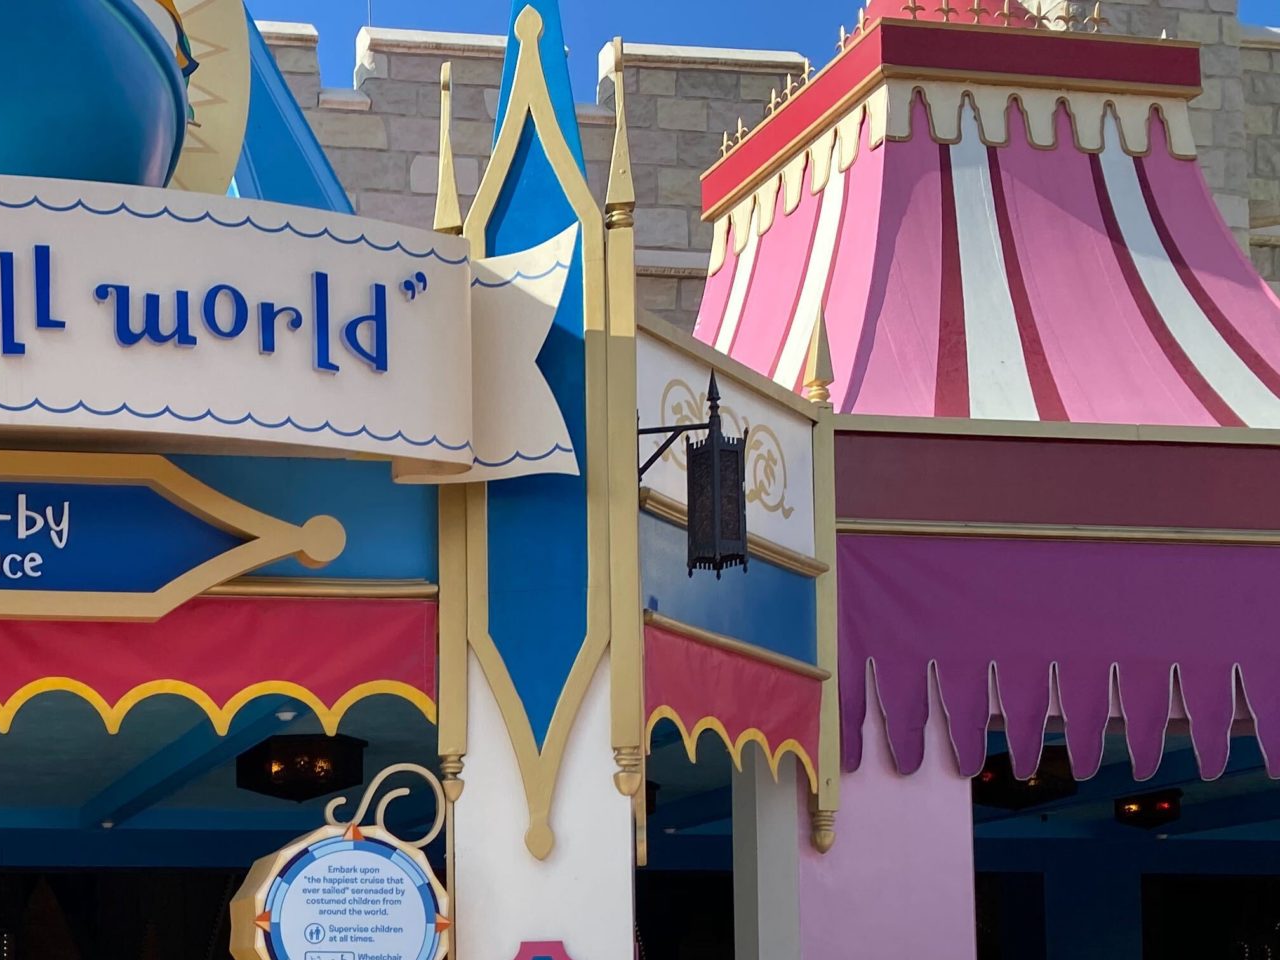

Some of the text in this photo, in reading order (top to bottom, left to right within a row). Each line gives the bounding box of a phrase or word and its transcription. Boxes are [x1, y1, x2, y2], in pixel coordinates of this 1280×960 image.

[327, 865, 380, 875] Embark upon
[304, 875, 404, 886] "the happiest cruise that
[302, 886, 406, 897] ever sailed" serenaded by
[306, 897, 402, 905] costumed children from
[318, 907, 389, 916] around the world.
[328, 924, 403, 935] Supervise children
[328, 934, 375, 943] at all times.
